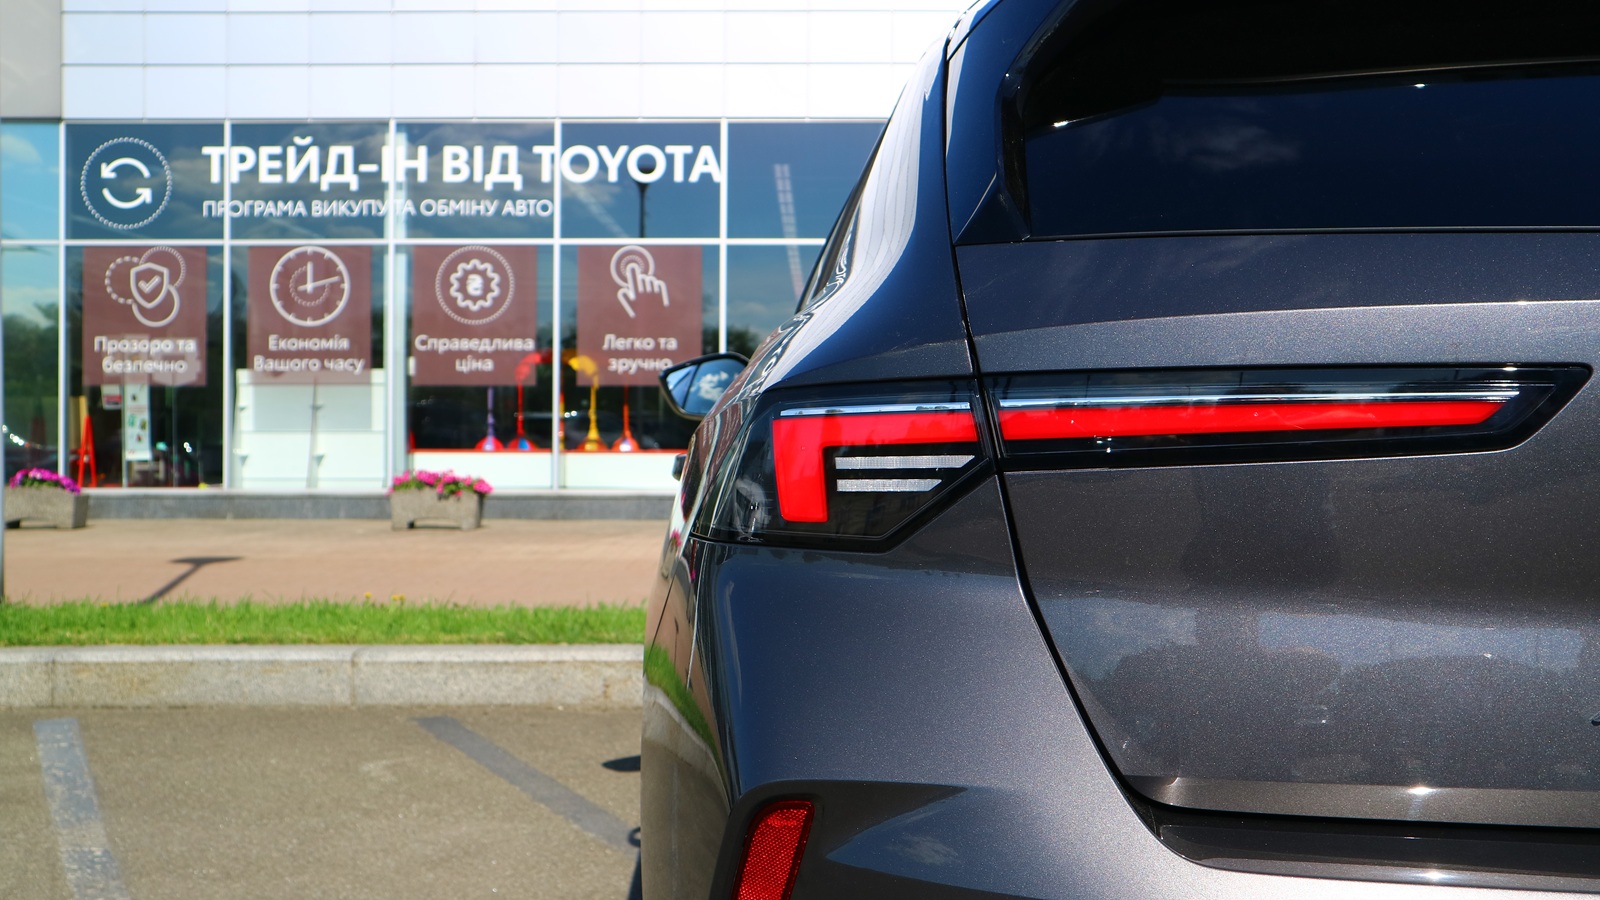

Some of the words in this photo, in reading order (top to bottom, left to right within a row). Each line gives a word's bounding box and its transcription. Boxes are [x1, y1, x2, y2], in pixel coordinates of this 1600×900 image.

[201, 135, 428, 192] ТРЕЙД-ІН
[442, 145, 524, 191] ВІД
[532, 144, 721, 183] TOYOTA
[202, 199, 308, 218] ПРОГРАМА
[311, 199, 389, 217] ВИКУПУ
[419, 198, 497, 217] ОБМІНУ
[501, 198, 554, 217] АВТО
[94, 335, 172, 354] Прозоро
[176, 339, 197, 352] та
[268, 334, 350, 351] Економія
[414, 334, 535, 353] Справедлива
[602, 333, 655, 351] Легко
[657, 337, 679, 351] та
[102, 356, 188, 374] безпечно
[253, 355, 321, 372] Вашого
[324, 358, 365, 376] часу
[455, 355, 494, 373] ціна
[608, 357, 673, 375] зручно
